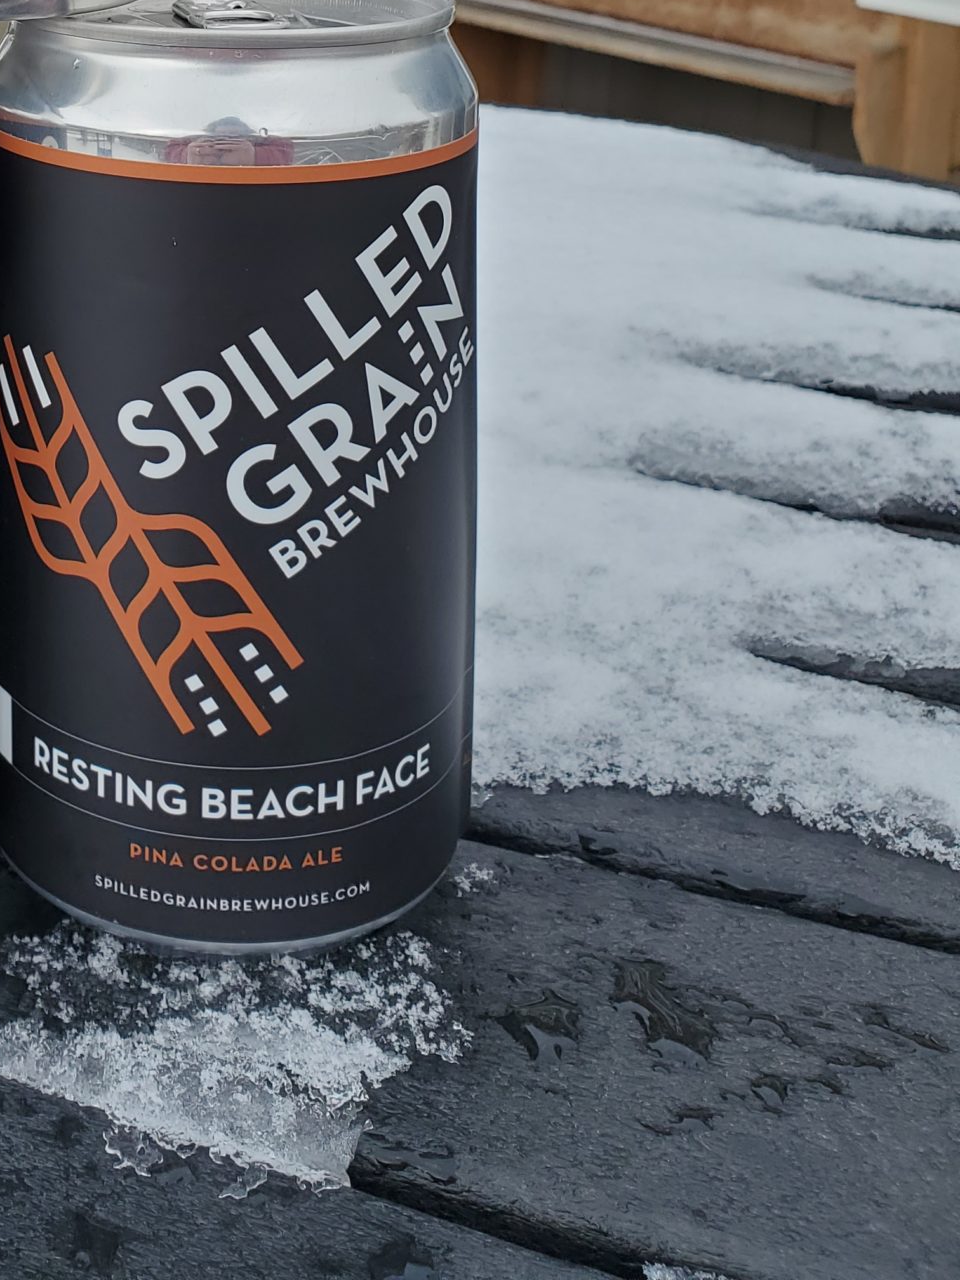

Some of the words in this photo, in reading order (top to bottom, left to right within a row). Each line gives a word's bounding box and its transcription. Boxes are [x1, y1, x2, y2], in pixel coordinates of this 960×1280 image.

[117, 184, 453, 480] SPILLED
[268, 326, 475, 579] BREWHOUSE
[34, 736, 187, 816] RESTING
[201, 779, 345, 821] BEACH
[356, 743, 431, 806] FACE
[94, 874, 371, 912] SPILLEDGRAINBREWHOUSE.COM
[129, 842, 184, 868] PINA
[193, 854, 292, 872] COLADA
[301, 846, 343, 868] ALE
